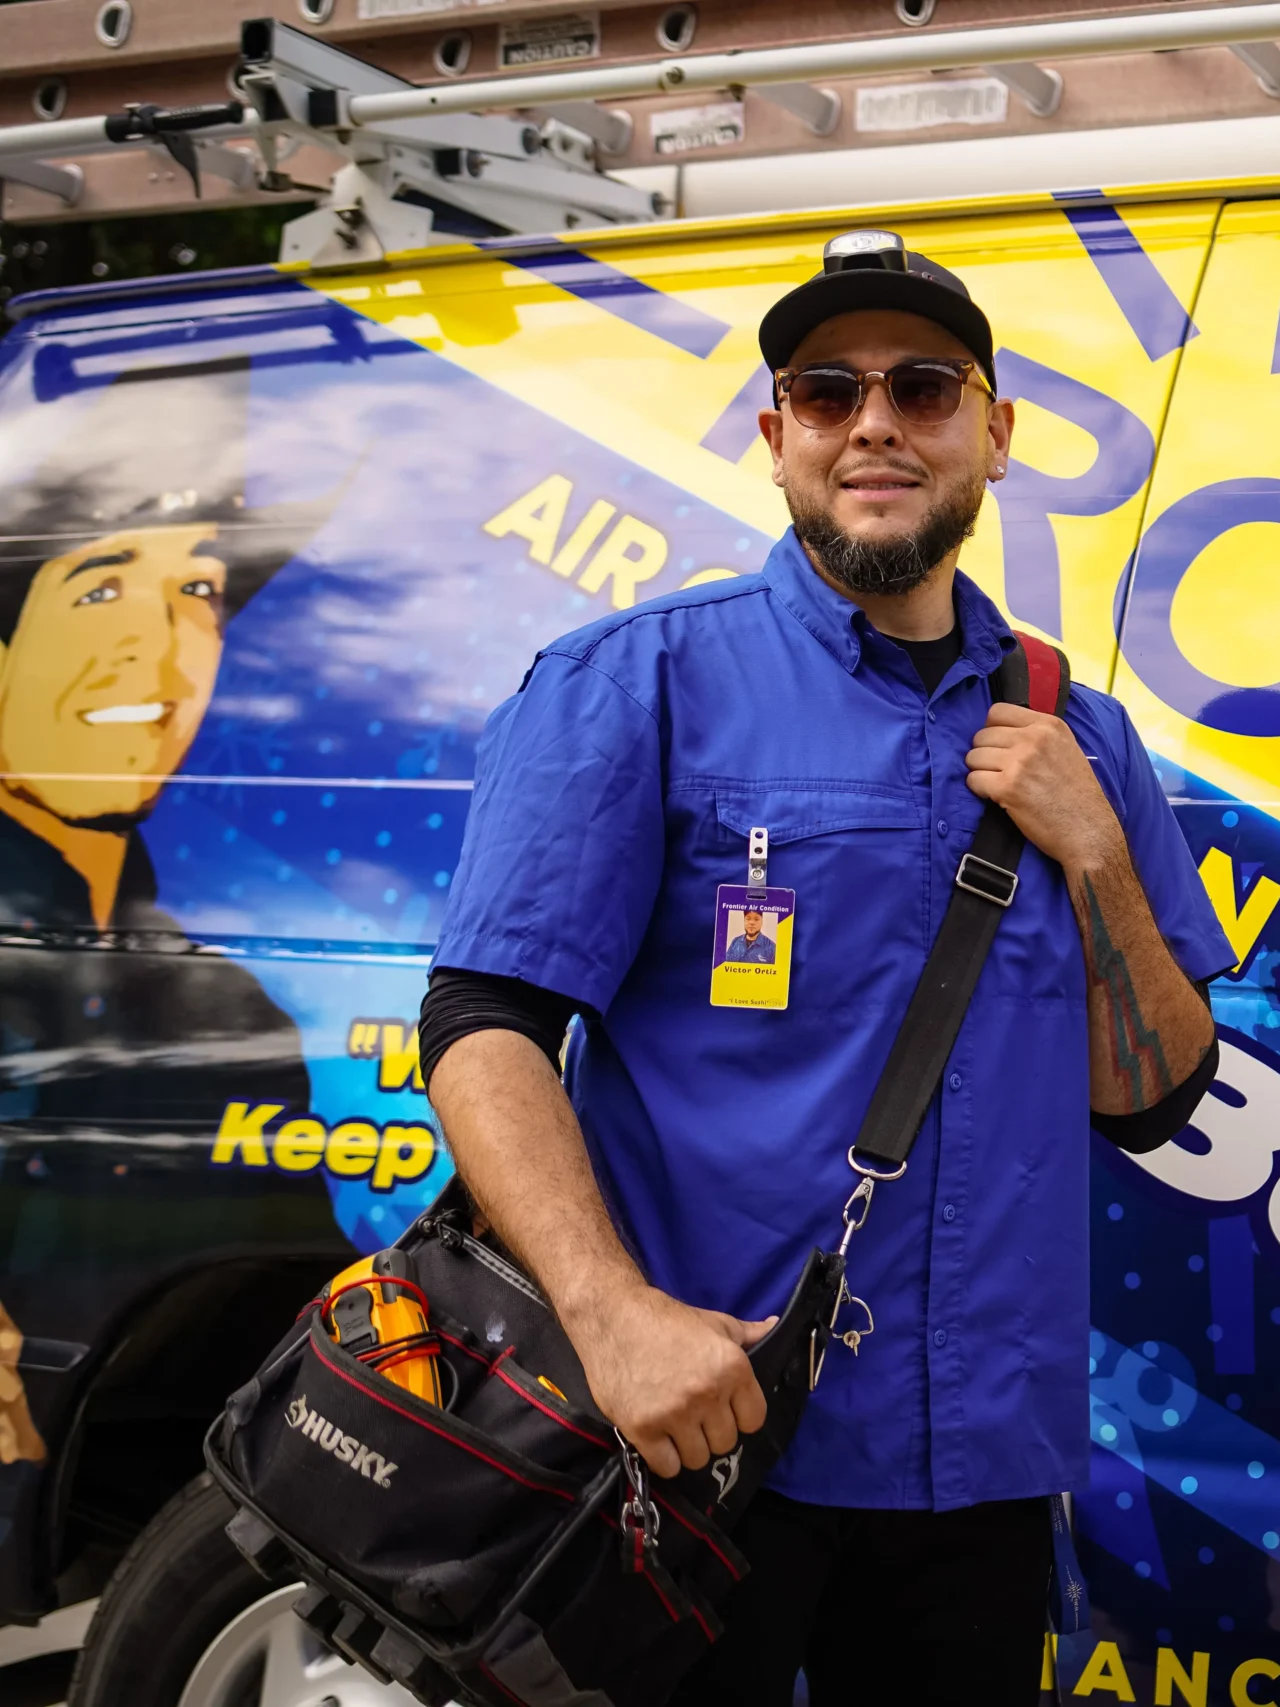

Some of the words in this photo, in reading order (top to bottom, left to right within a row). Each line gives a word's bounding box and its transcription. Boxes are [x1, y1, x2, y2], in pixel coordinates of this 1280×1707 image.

[510, 40, 591, 63] CAUTION
[483, 474, 668, 612] AIR
[722, 902, 748, 911] Frontier
[759, 905, 790, 913] Condition
[724, 966, 752, 974] Victor
[754, 967, 778, 975] Ortiz
[211, 1101, 436, 1189] Keep
